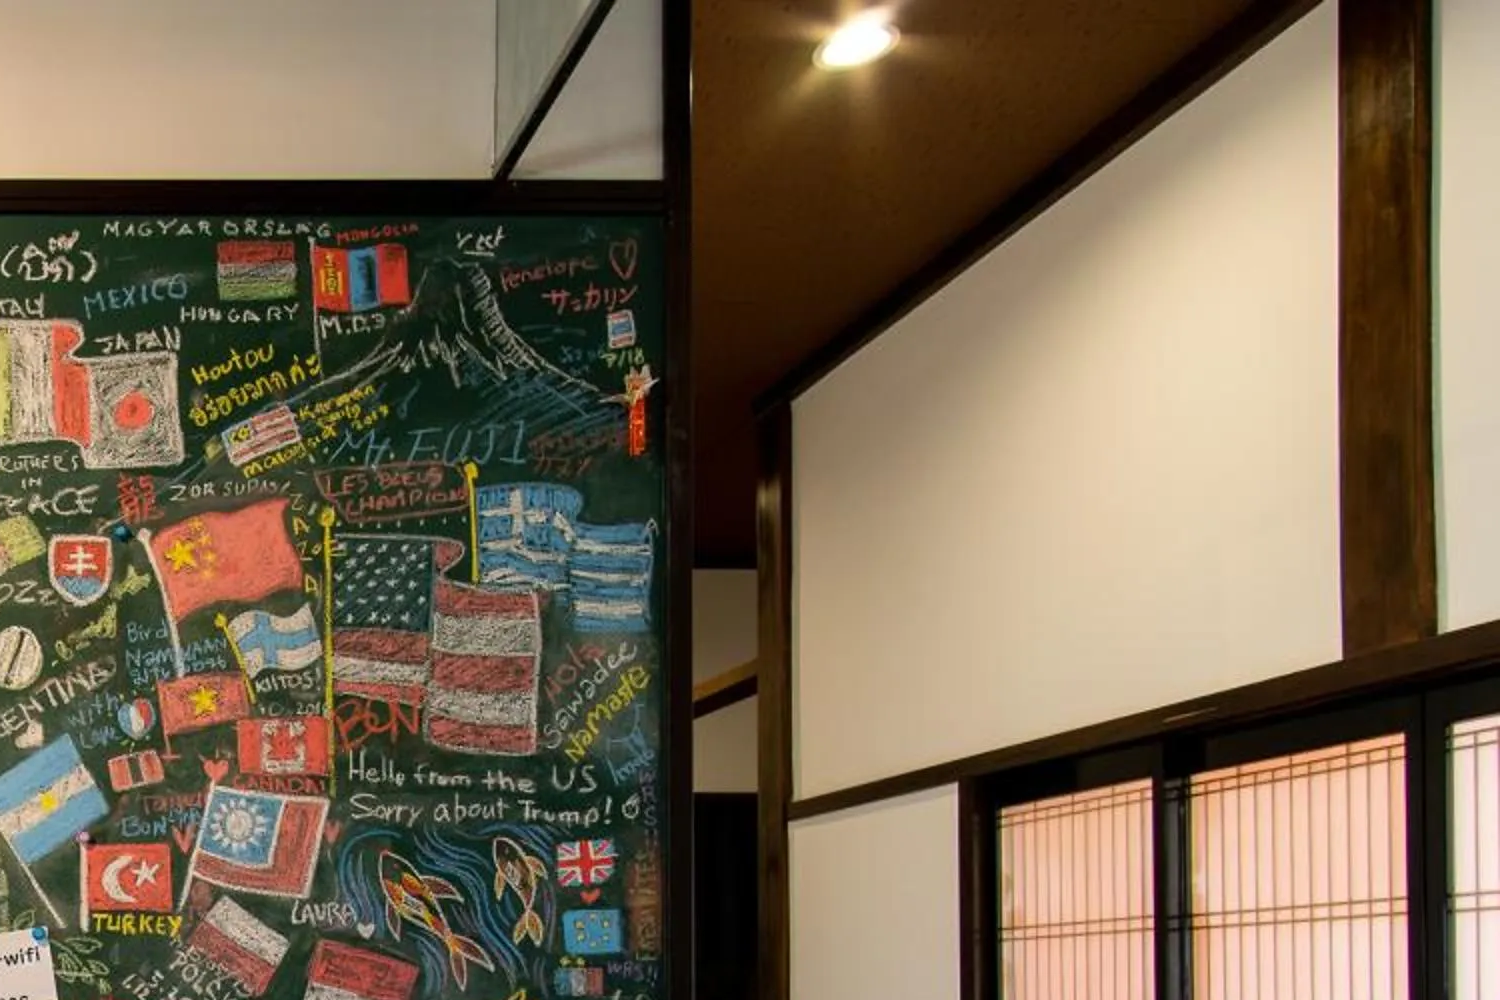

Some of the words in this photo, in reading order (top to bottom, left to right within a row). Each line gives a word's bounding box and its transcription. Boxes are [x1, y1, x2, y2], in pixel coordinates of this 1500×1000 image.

[84, 273, 190, 321] MEXICO
[180, 304, 300, 323] HUNGARY
[92, 325, 181, 354] JAPAN
[482, 766, 536, 794] the
[552, 764, 599, 794] US
[349, 793, 423, 827] Sorry
[433, 794, 507, 822] about
[518, 796, 612, 827] Trump!
[92, 913, 182, 938] TURKEY
